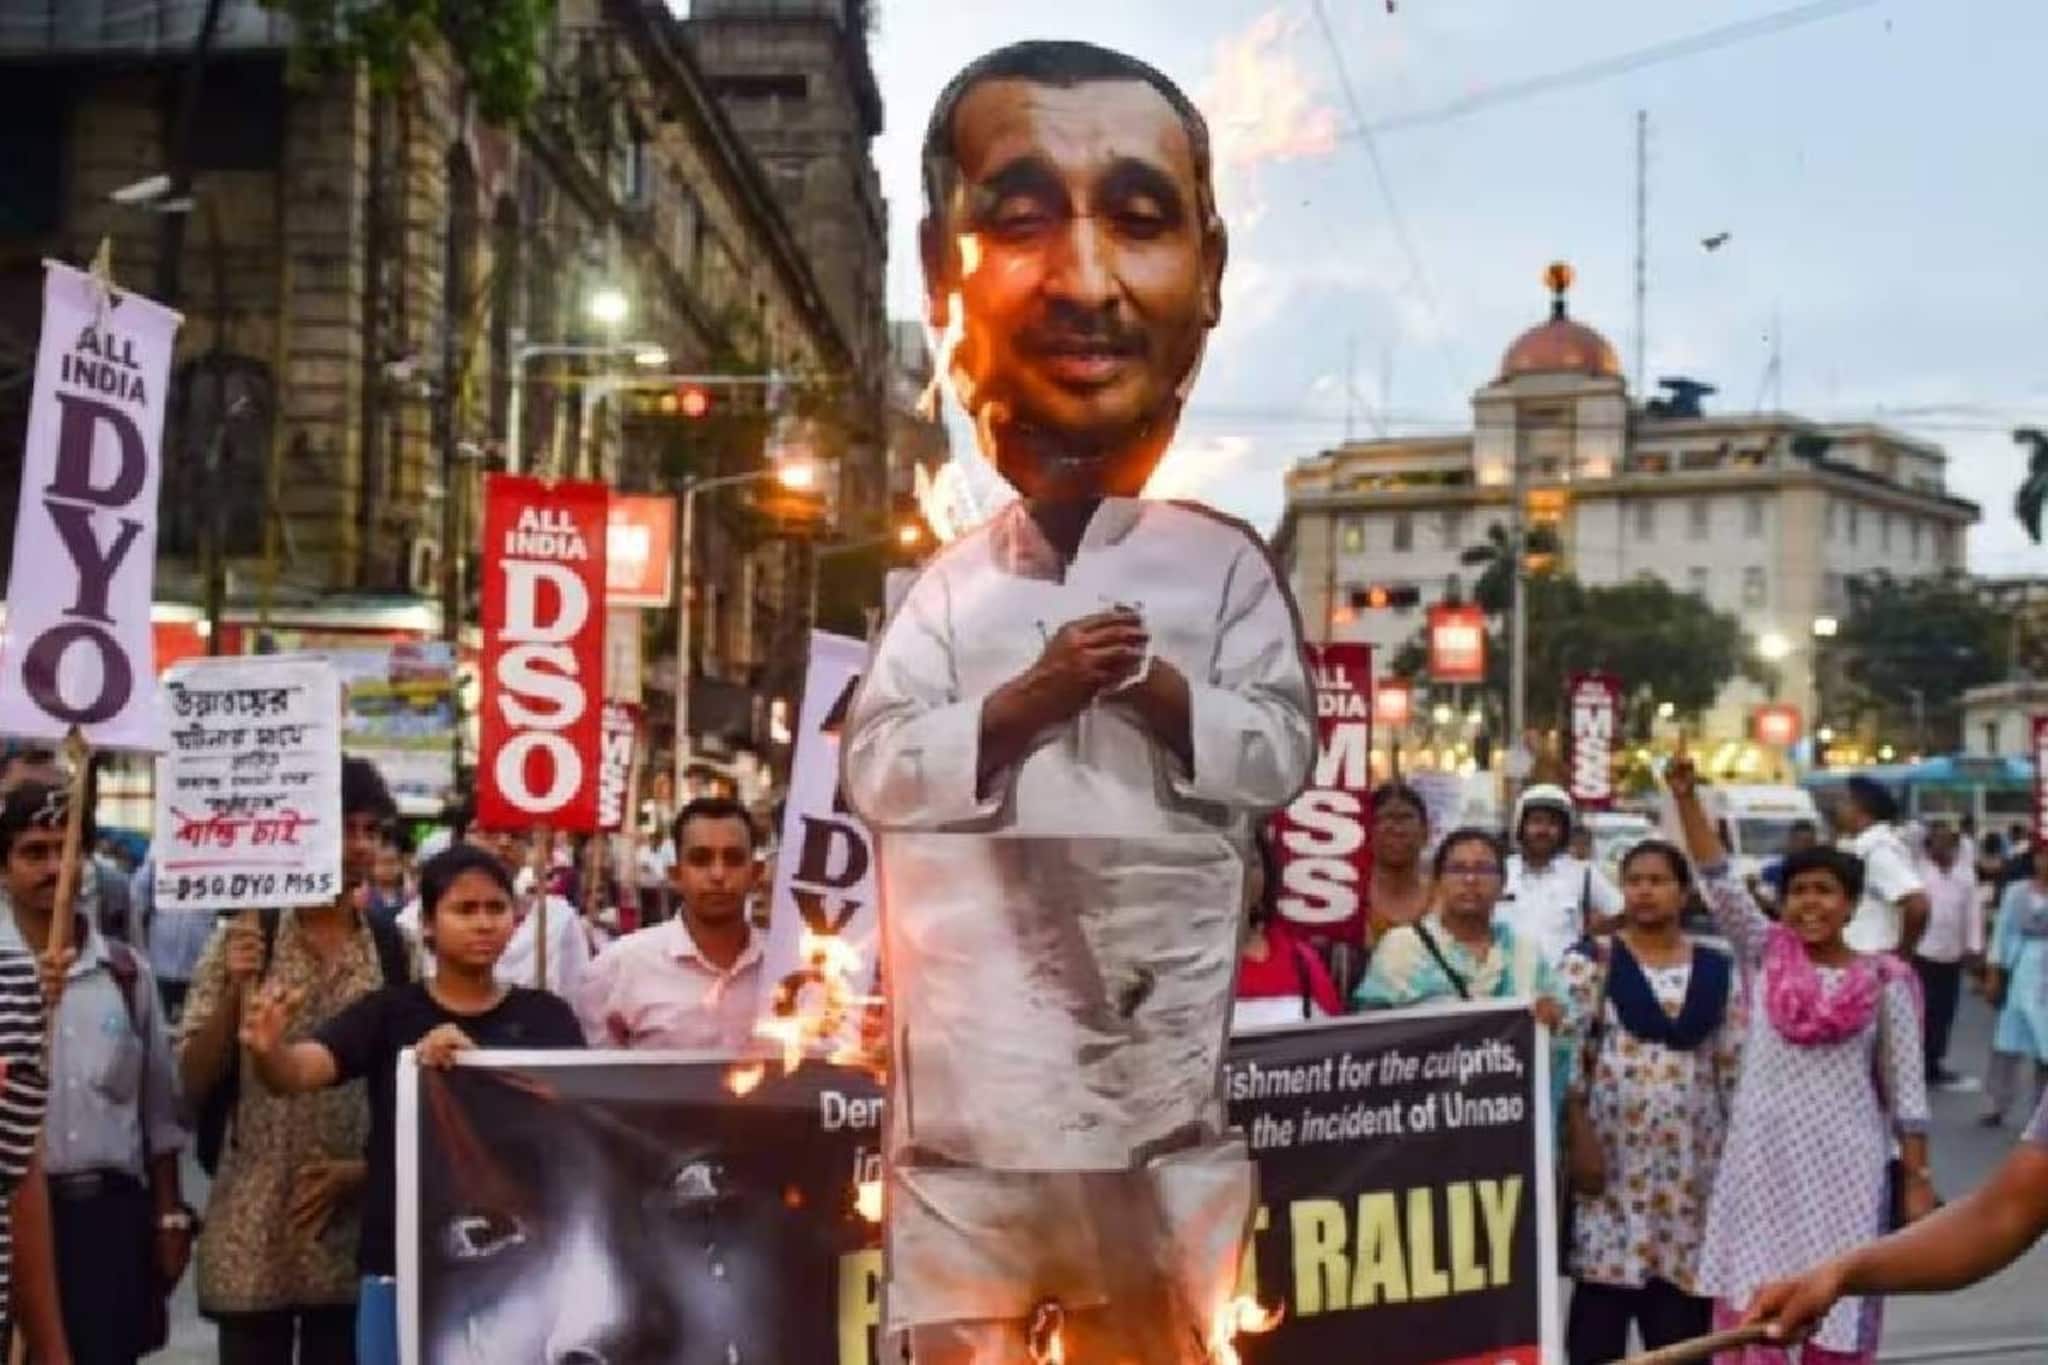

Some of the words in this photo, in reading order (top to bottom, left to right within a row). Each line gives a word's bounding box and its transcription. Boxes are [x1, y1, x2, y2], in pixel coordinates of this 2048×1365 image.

[76, 325, 142, 369] ALL
[61, 354, 149, 404] INDIA
[517, 505, 577, 534] ALL
[505, 532, 588, 560] INDIA
[1317, 693, 1367, 717] DIA
[1224, 1058, 1333, 1101] ishment
[1338, 1053, 1374, 1091] for
[1380, 1050, 1420, 1084] the
[1424, 1038, 1524, 1086] culprits,
[1252, 1112, 1292, 1149] the
[1300, 1100, 1405, 1144] incident
[1408, 1094, 1438, 1132] of
[1444, 1091, 1525, 1128] Unnao
[1290, 1174, 1524, 1317] RALLY
